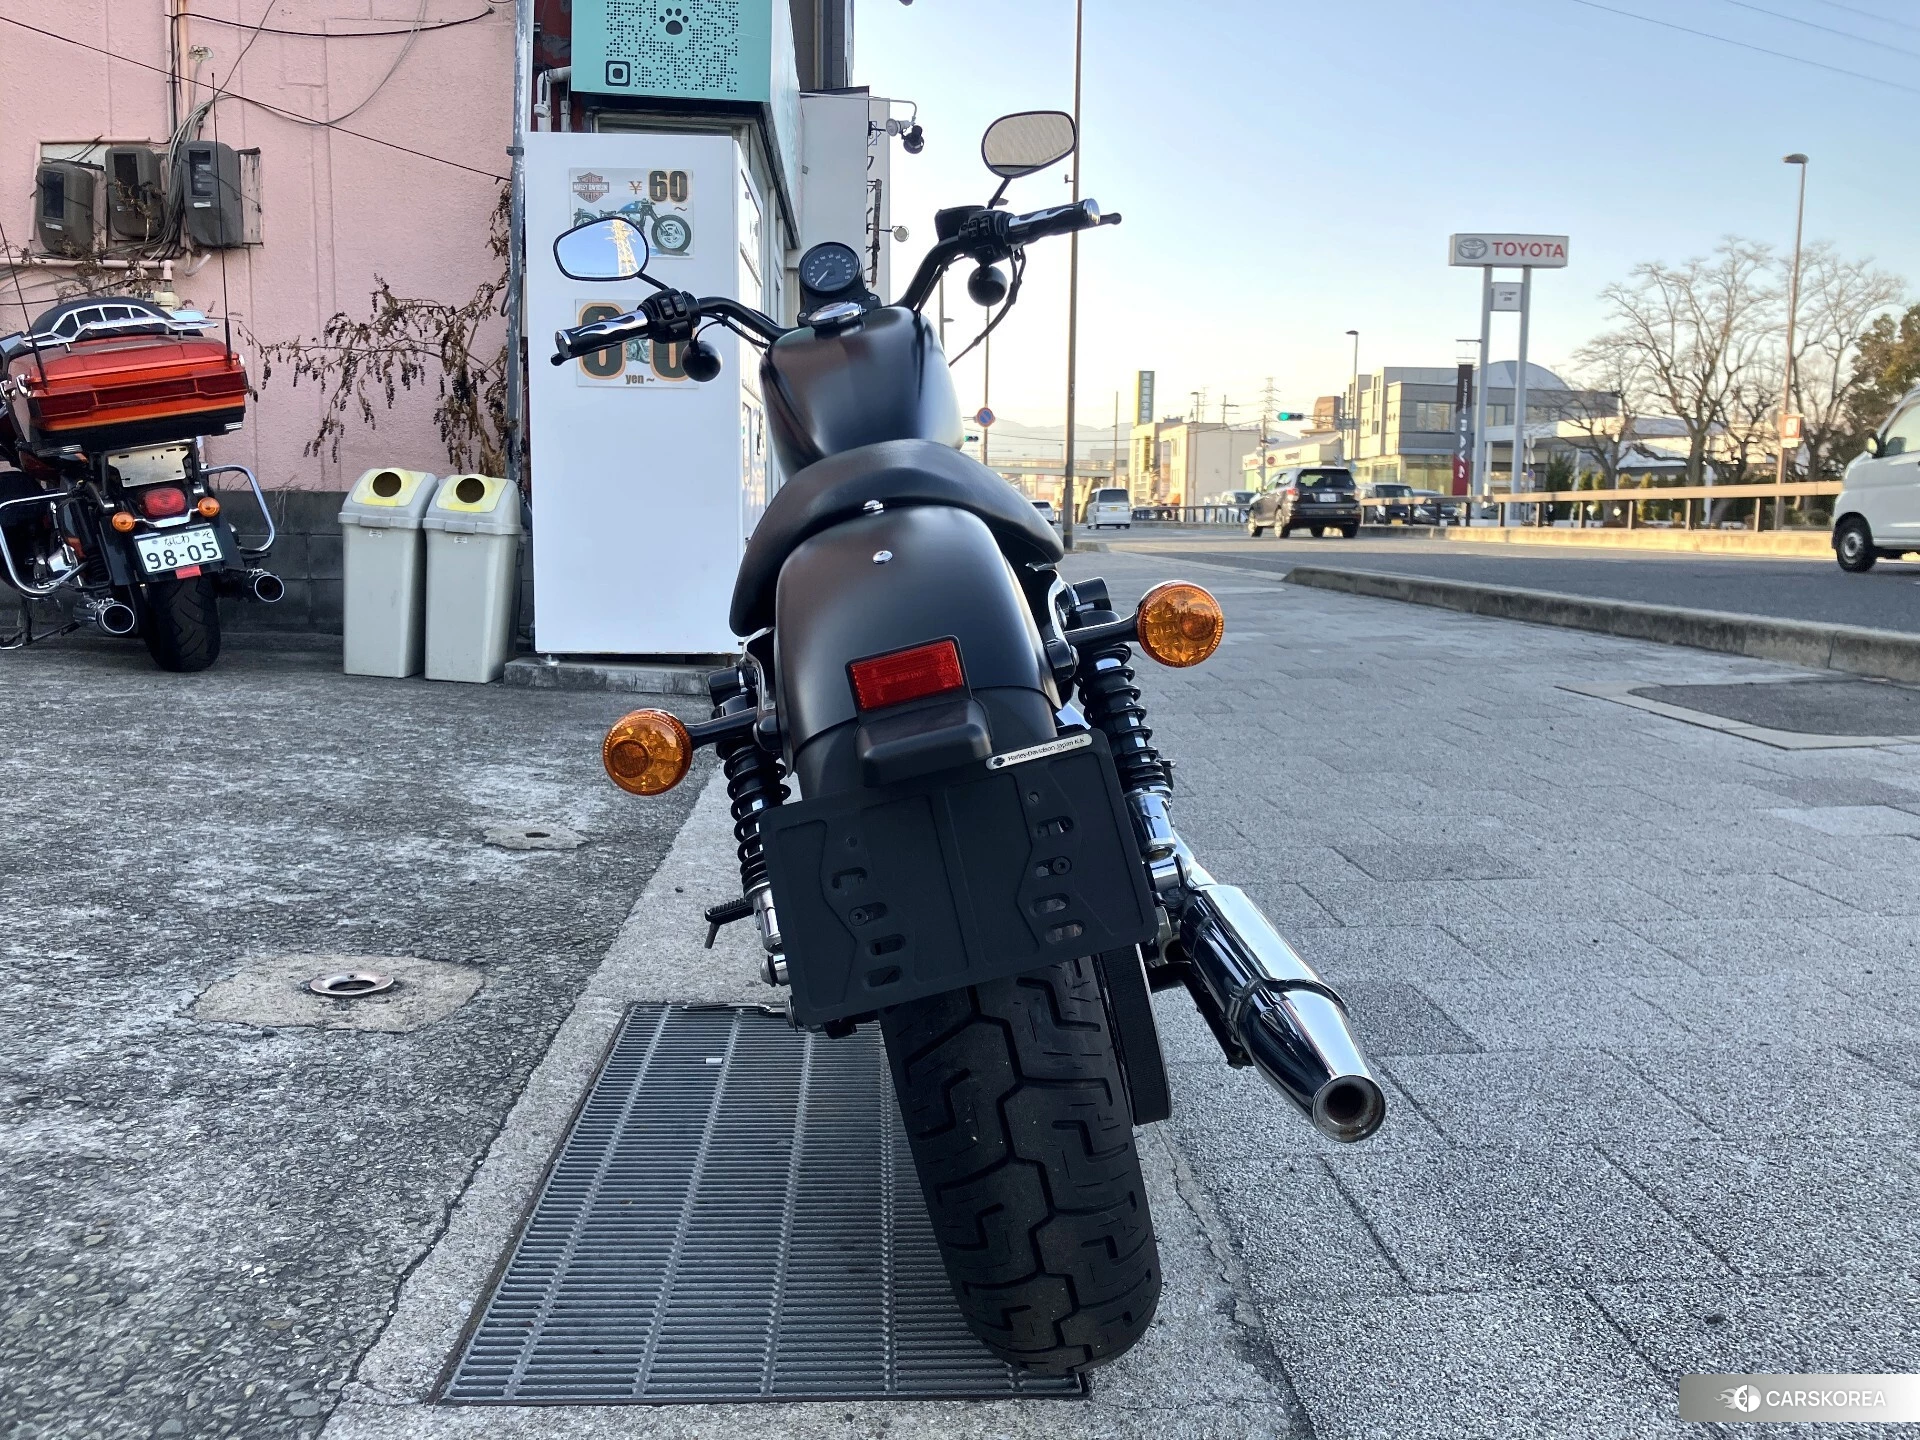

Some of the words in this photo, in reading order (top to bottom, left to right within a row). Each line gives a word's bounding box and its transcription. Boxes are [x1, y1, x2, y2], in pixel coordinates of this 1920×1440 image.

[649, 170, 688, 202] 60
[1492, 242, 1564, 258] TOYOTA
[626, 374, 644, 384] yen
[164, 535, 190, 546] なにわ
[146, 541, 218, 570] 98-05
[1008, 744, 1056, 762] Harley-Davidson
[1056, 740, 1074, 751] Japan
